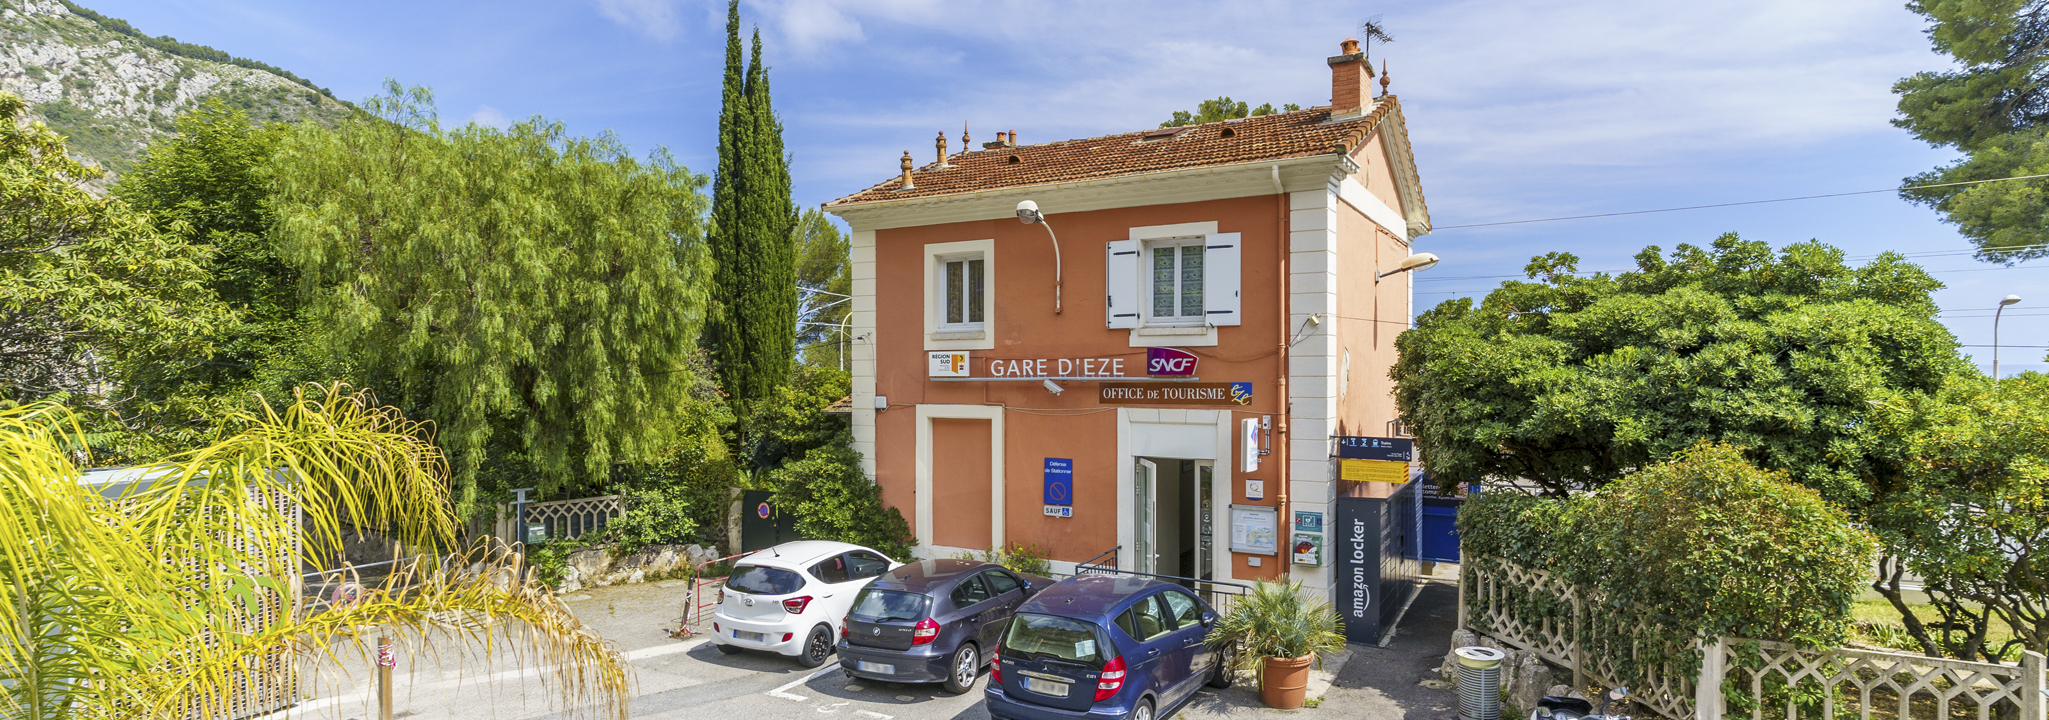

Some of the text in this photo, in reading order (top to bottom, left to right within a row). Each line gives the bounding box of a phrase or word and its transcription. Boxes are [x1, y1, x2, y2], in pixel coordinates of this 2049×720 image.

[990, 357, 1124, 377] GARE D'EZE
[1149, 357, 1194, 372] SNCF
[1103, 387, 1226, 401] OFFICE DE TOURISME
[1350, 518, 1365, 618] amazon locker
